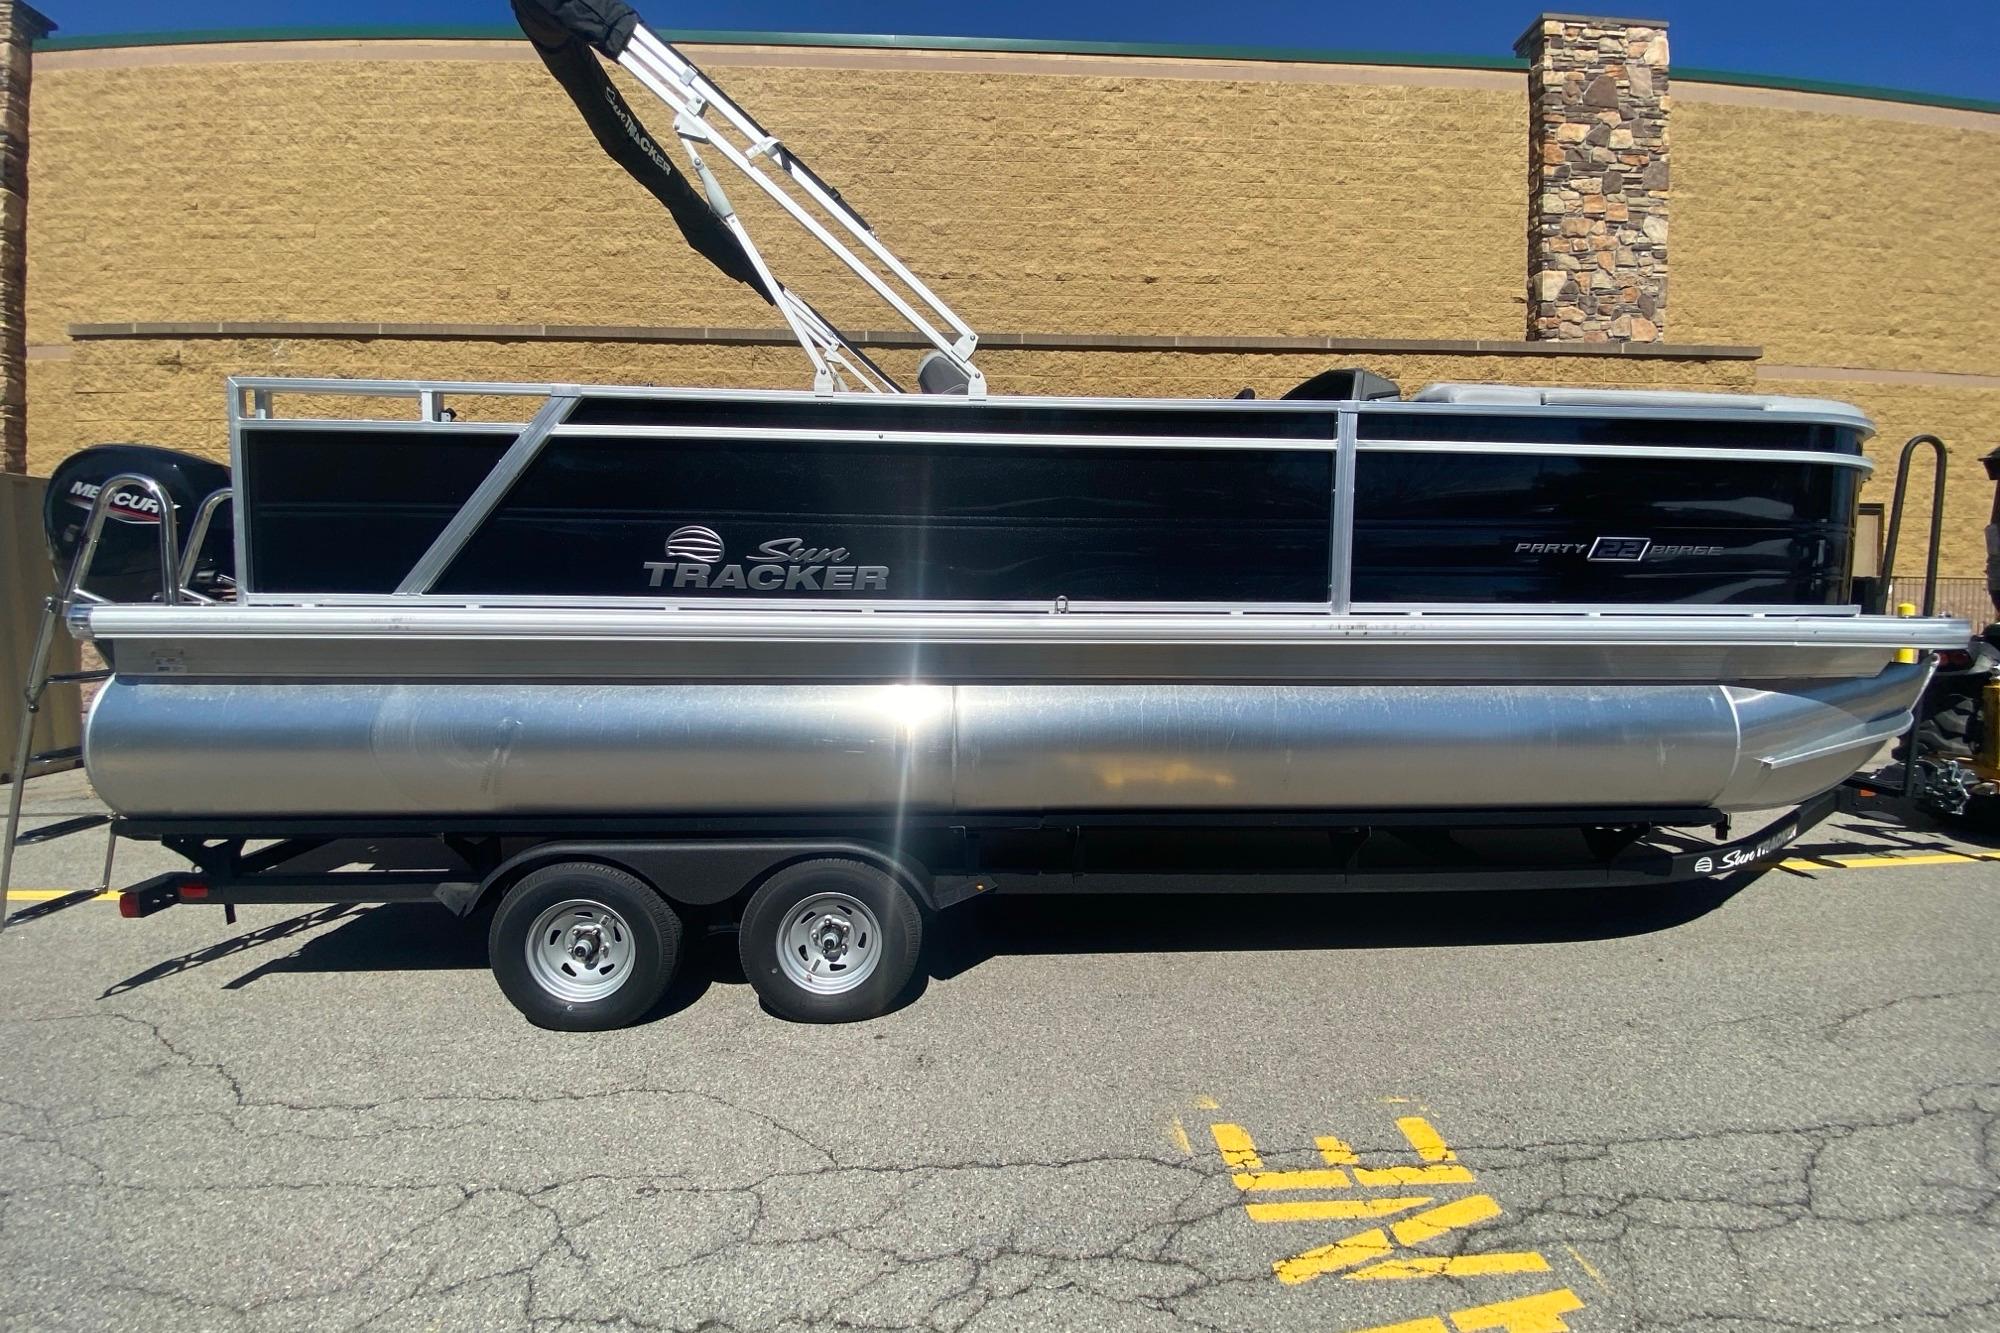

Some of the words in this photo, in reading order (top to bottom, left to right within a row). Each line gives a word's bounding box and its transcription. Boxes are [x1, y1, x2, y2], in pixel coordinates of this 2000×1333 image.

[71, 482, 182, 513] MECUR
[746, 537, 850, 564] Sun
[1514, 543, 1587, 553] PARTY
[1601, 541, 1642, 558] 22
[1649, 545, 1725, 556] BARGE
[643, 561, 890, 591] TRACKER
[1716, 849, 1755, 869] Sun
